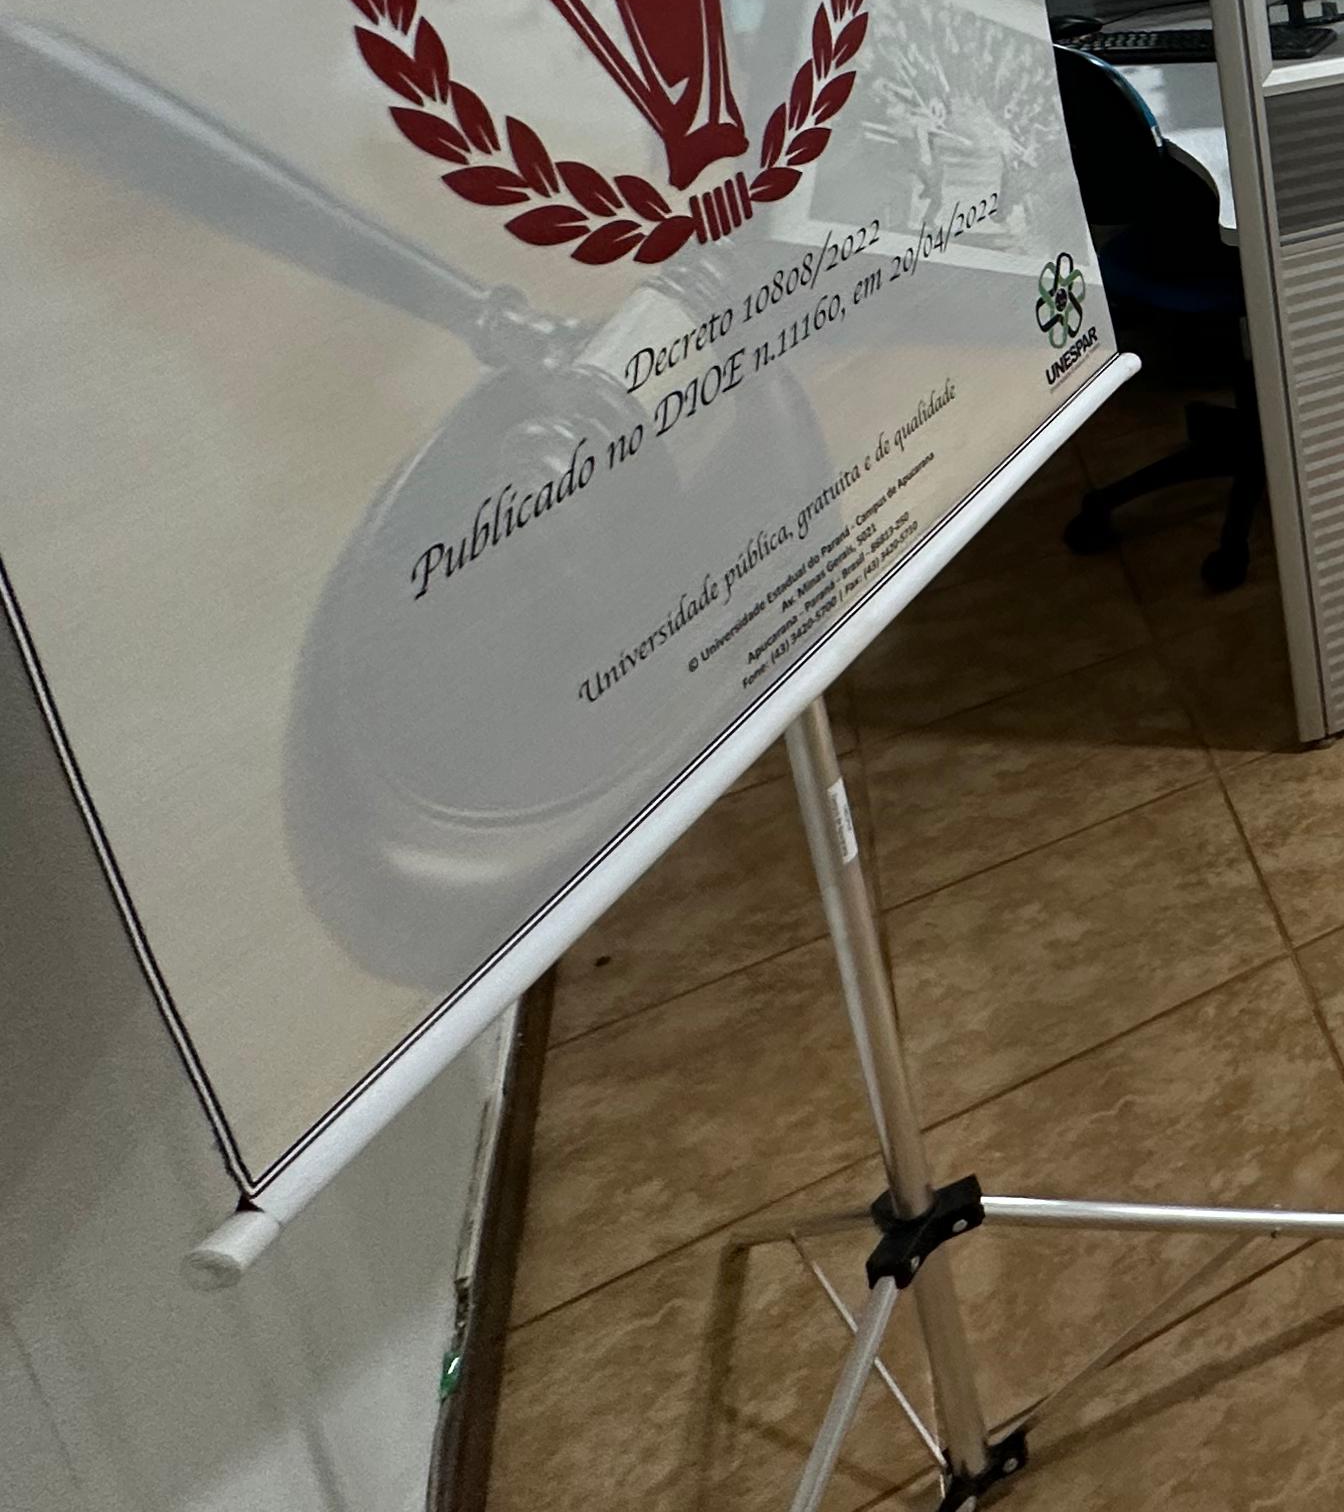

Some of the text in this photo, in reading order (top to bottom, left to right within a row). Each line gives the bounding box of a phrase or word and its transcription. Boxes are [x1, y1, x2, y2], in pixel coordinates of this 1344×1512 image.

[625, 220, 880, 394] Decreto 10808/2022
[1046, 326, 1099, 385] UNESPAR
[411, 193, 998, 600] Publicado no DIOE n.11160, em 20/04/2022
[578, 377, 956, 702] Universidade pública, gratuita e de qualidade
[700, 600, 766, 661] Universidade
[767, 562, 806, 604] Estadual
[807, 554, 820, 569] do
[855, 495, 887, 526] Campus
[747, 615, 798, 665] Apucarana
